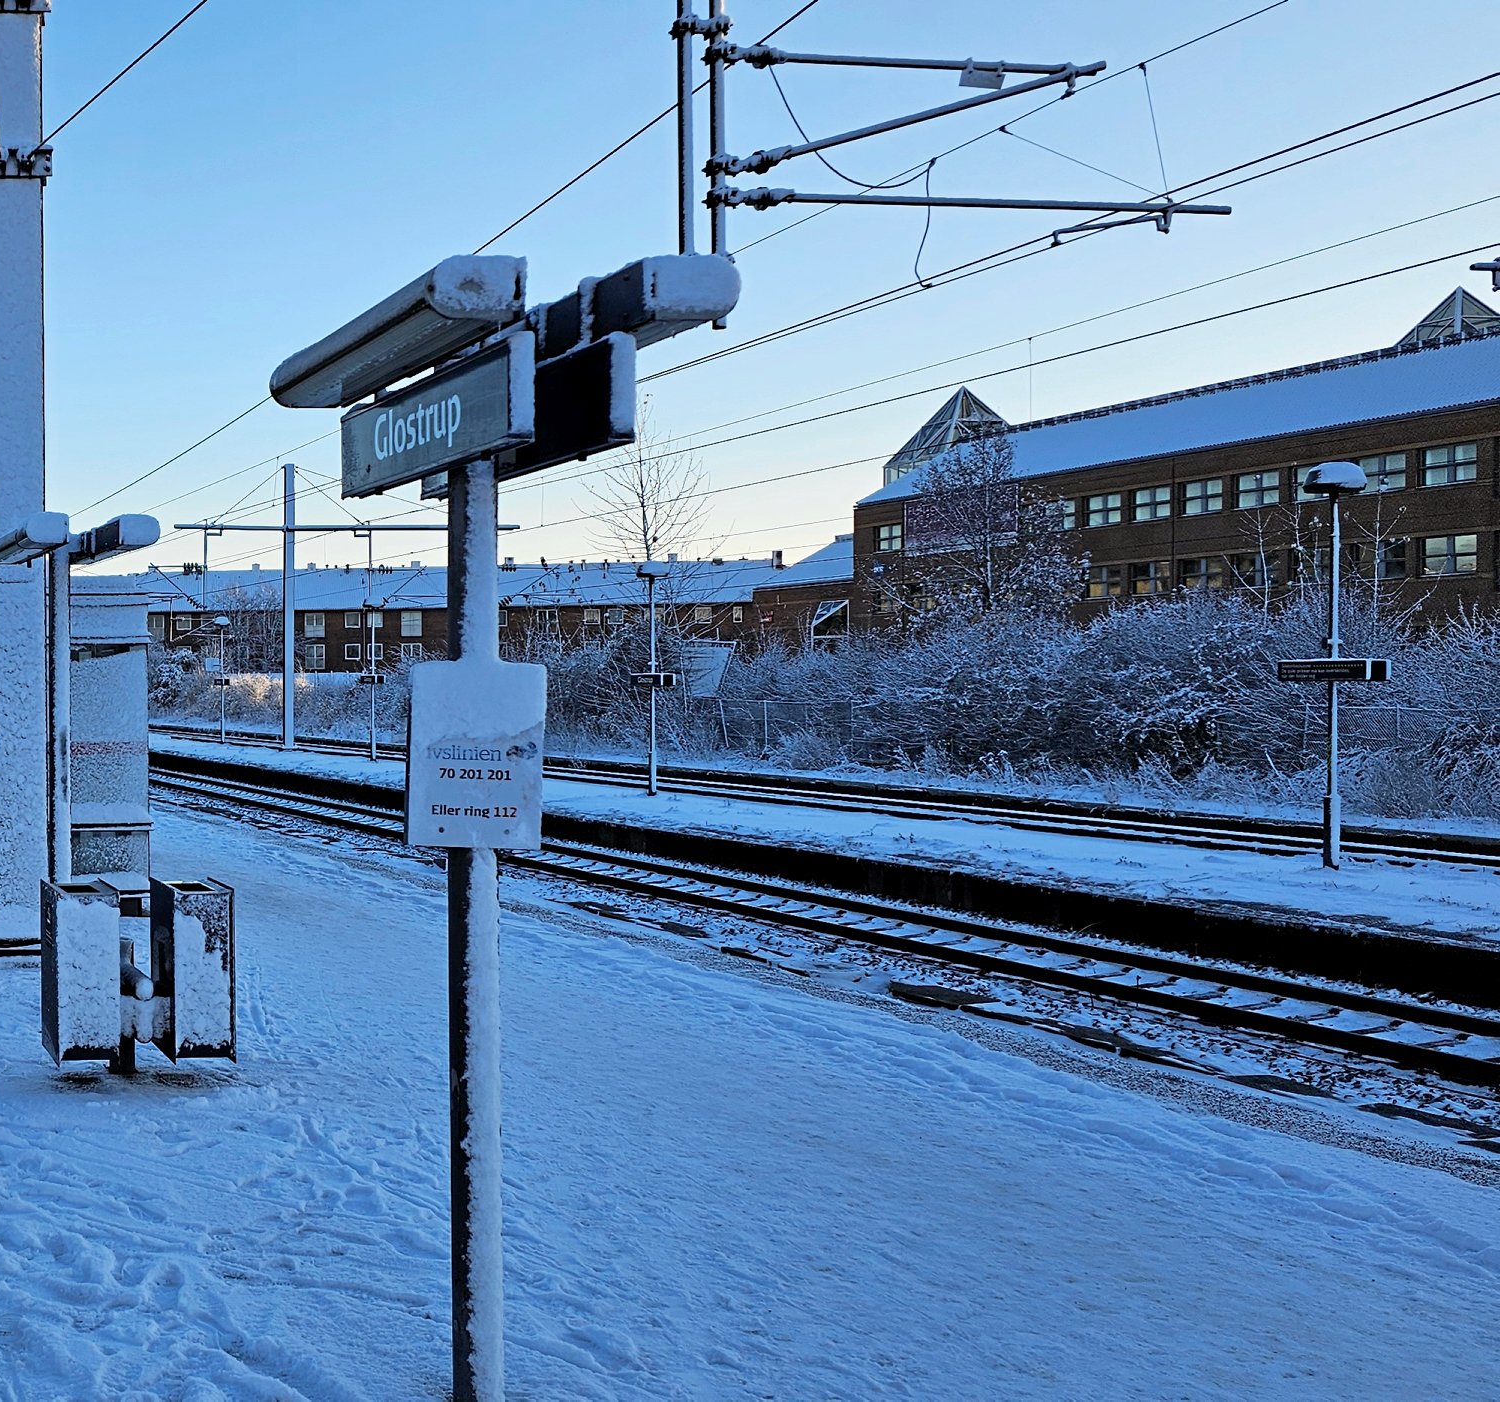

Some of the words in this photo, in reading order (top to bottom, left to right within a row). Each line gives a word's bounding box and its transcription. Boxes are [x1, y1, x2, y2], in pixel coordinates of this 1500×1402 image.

[374, 394, 461, 460] Glostrup
[439, 768, 455, 779] 70
[460, 769, 483, 780] 201
[487, 769, 511, 781] 201
[432, 804, 460, 816] Eller
[464, 805, 489, 818] ring
[494, 807, 517, 818] 112
